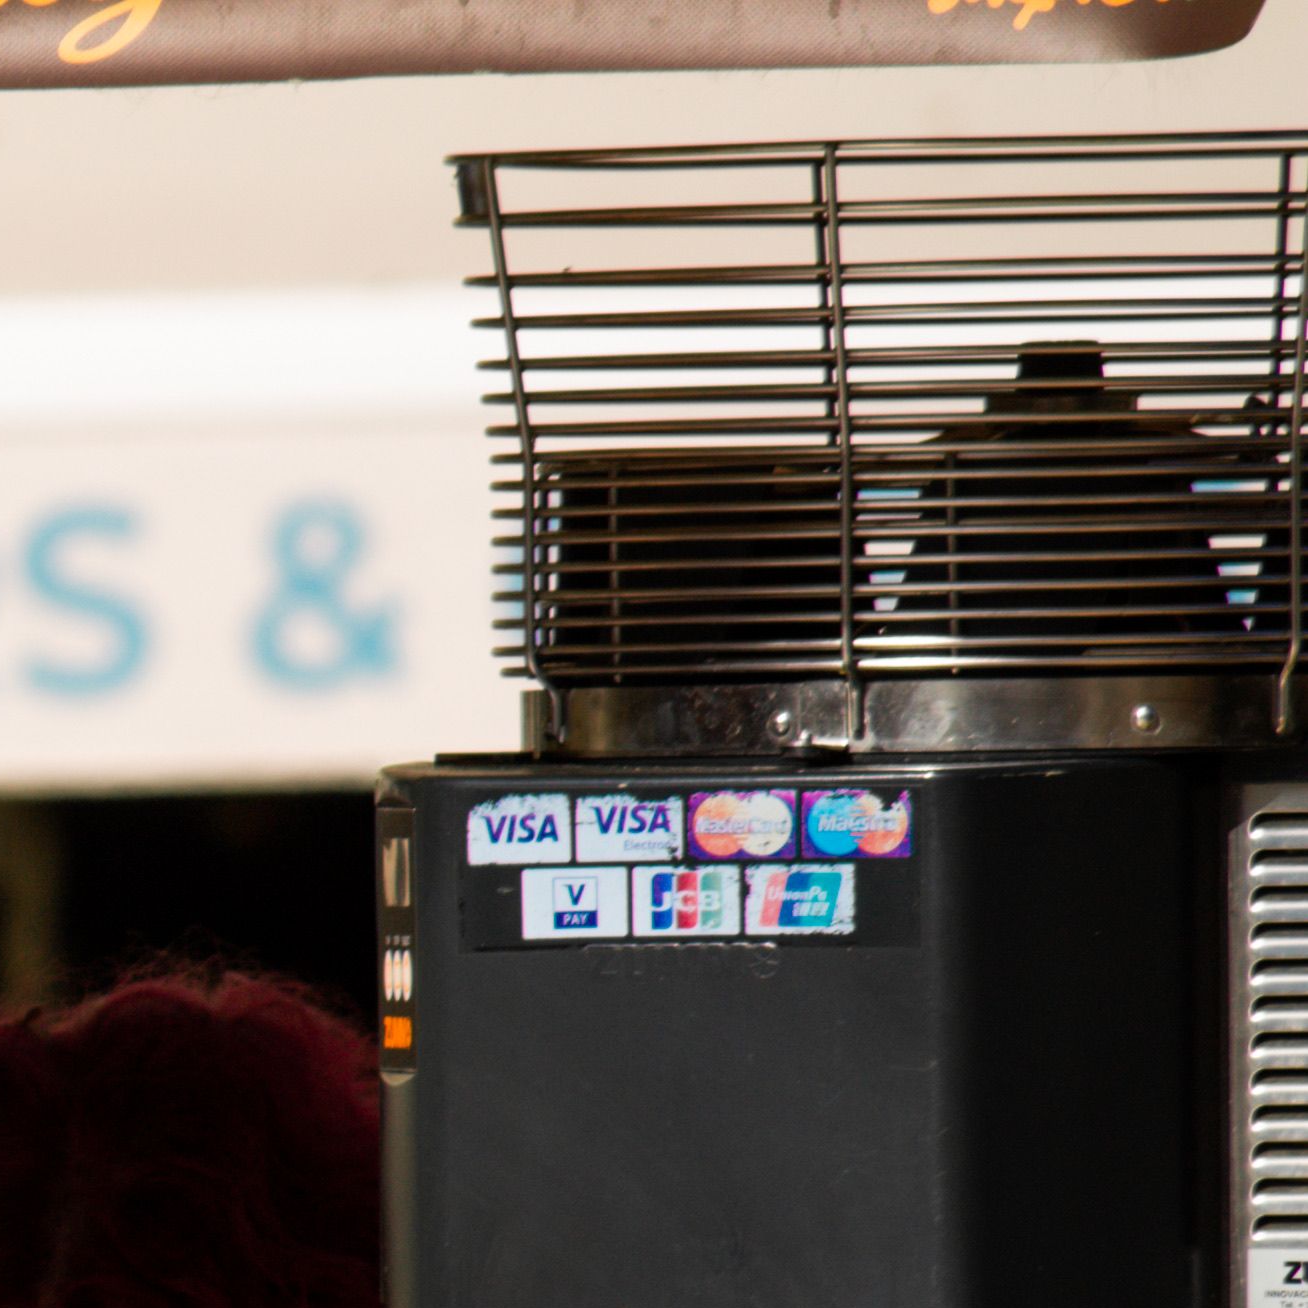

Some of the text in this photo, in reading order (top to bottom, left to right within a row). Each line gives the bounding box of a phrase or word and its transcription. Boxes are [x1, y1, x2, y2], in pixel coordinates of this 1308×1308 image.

[246, 500, 399, 692] &
[485, 813, 559, 844] VISA
[594, 804, 671, 835] VISA
[565, 884, 586, 906] V
[651, 890, 721, 912] JCB
[563, 913, 588, 926] PAY
[1283, 1261, 1308, 1285] Z
